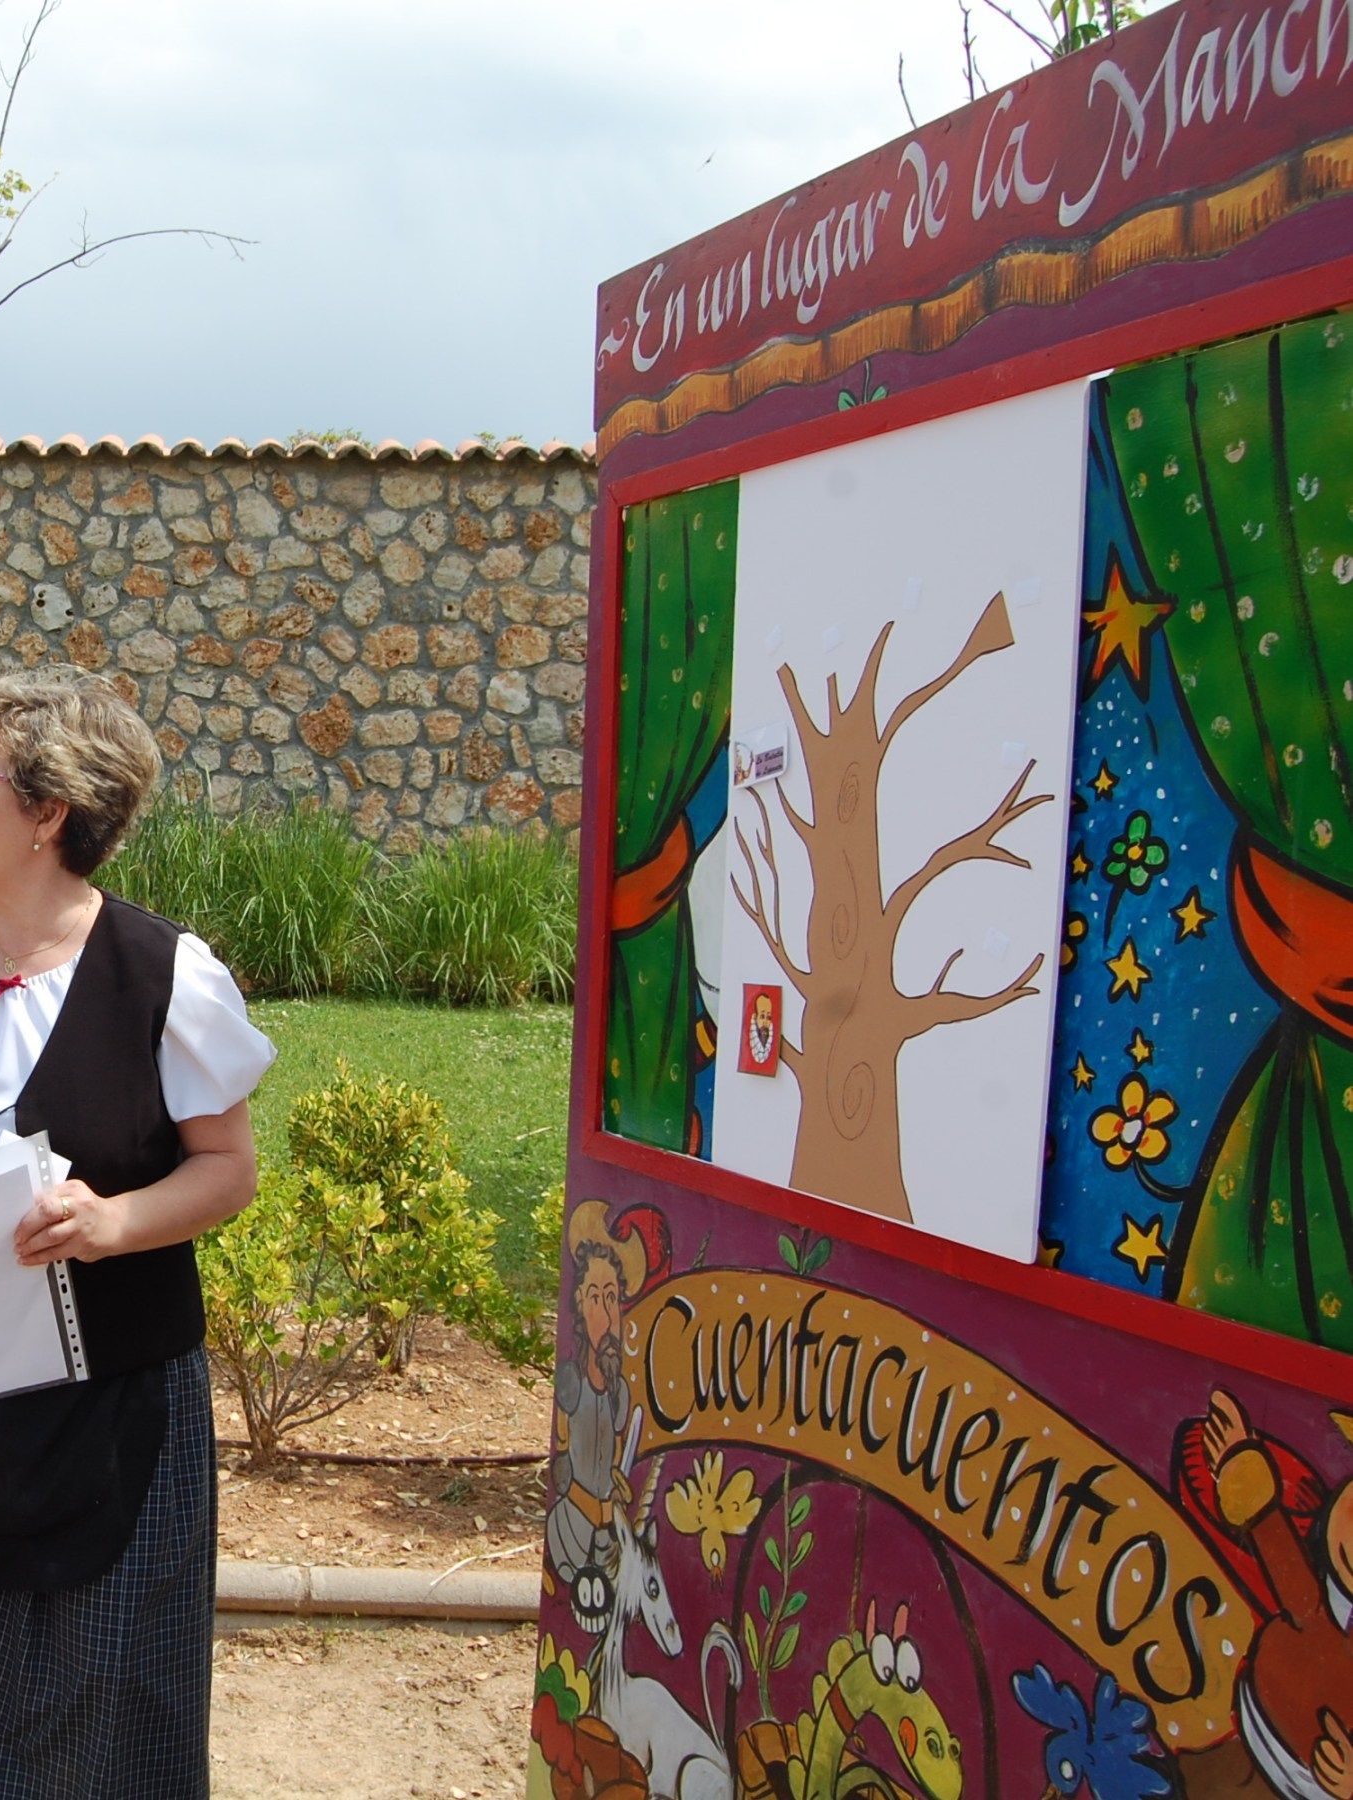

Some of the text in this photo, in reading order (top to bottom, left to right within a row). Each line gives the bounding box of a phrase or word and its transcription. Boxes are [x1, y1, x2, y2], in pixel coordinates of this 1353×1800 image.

[631, 262, 686, 372] En
[697, 250, 751, 334] un
[761, 196, 891, 324] lugar
[897, 141, 953, 248] de
[972, 90, 1057, 221] la
[644, 1290, 1228, 1704] Cuentacuentos
